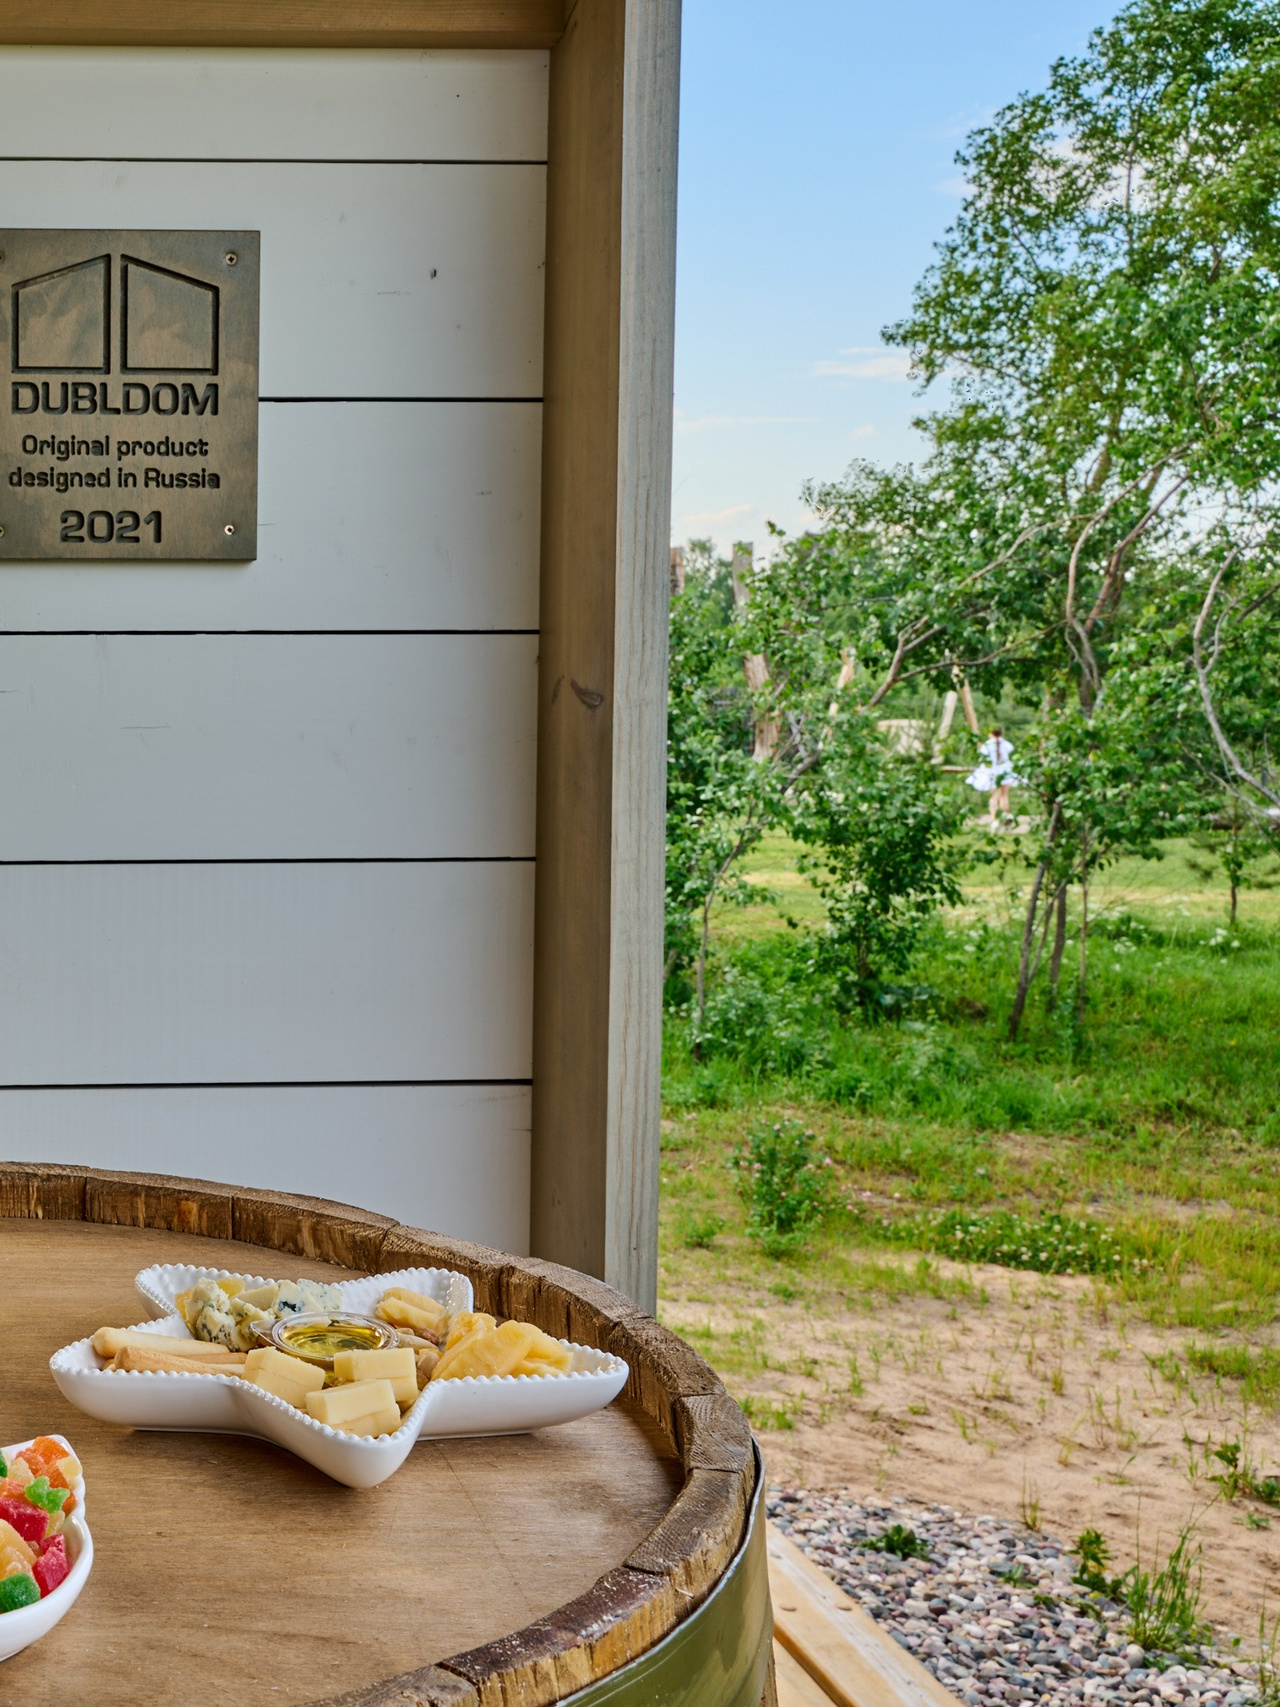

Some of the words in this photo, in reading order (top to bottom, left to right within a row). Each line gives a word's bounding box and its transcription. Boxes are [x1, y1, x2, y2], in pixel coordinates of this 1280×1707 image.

[11, 381, 219, 416] DUBLDOM
[21, 434, 110, 461] Original
[117, 436, 209, 461] product
[8, 466, 111, 493] designed
[117, 468, 137, 488] in
[144, 467, 220, 490] Russia
[60, 510, 162, 544] 2021
